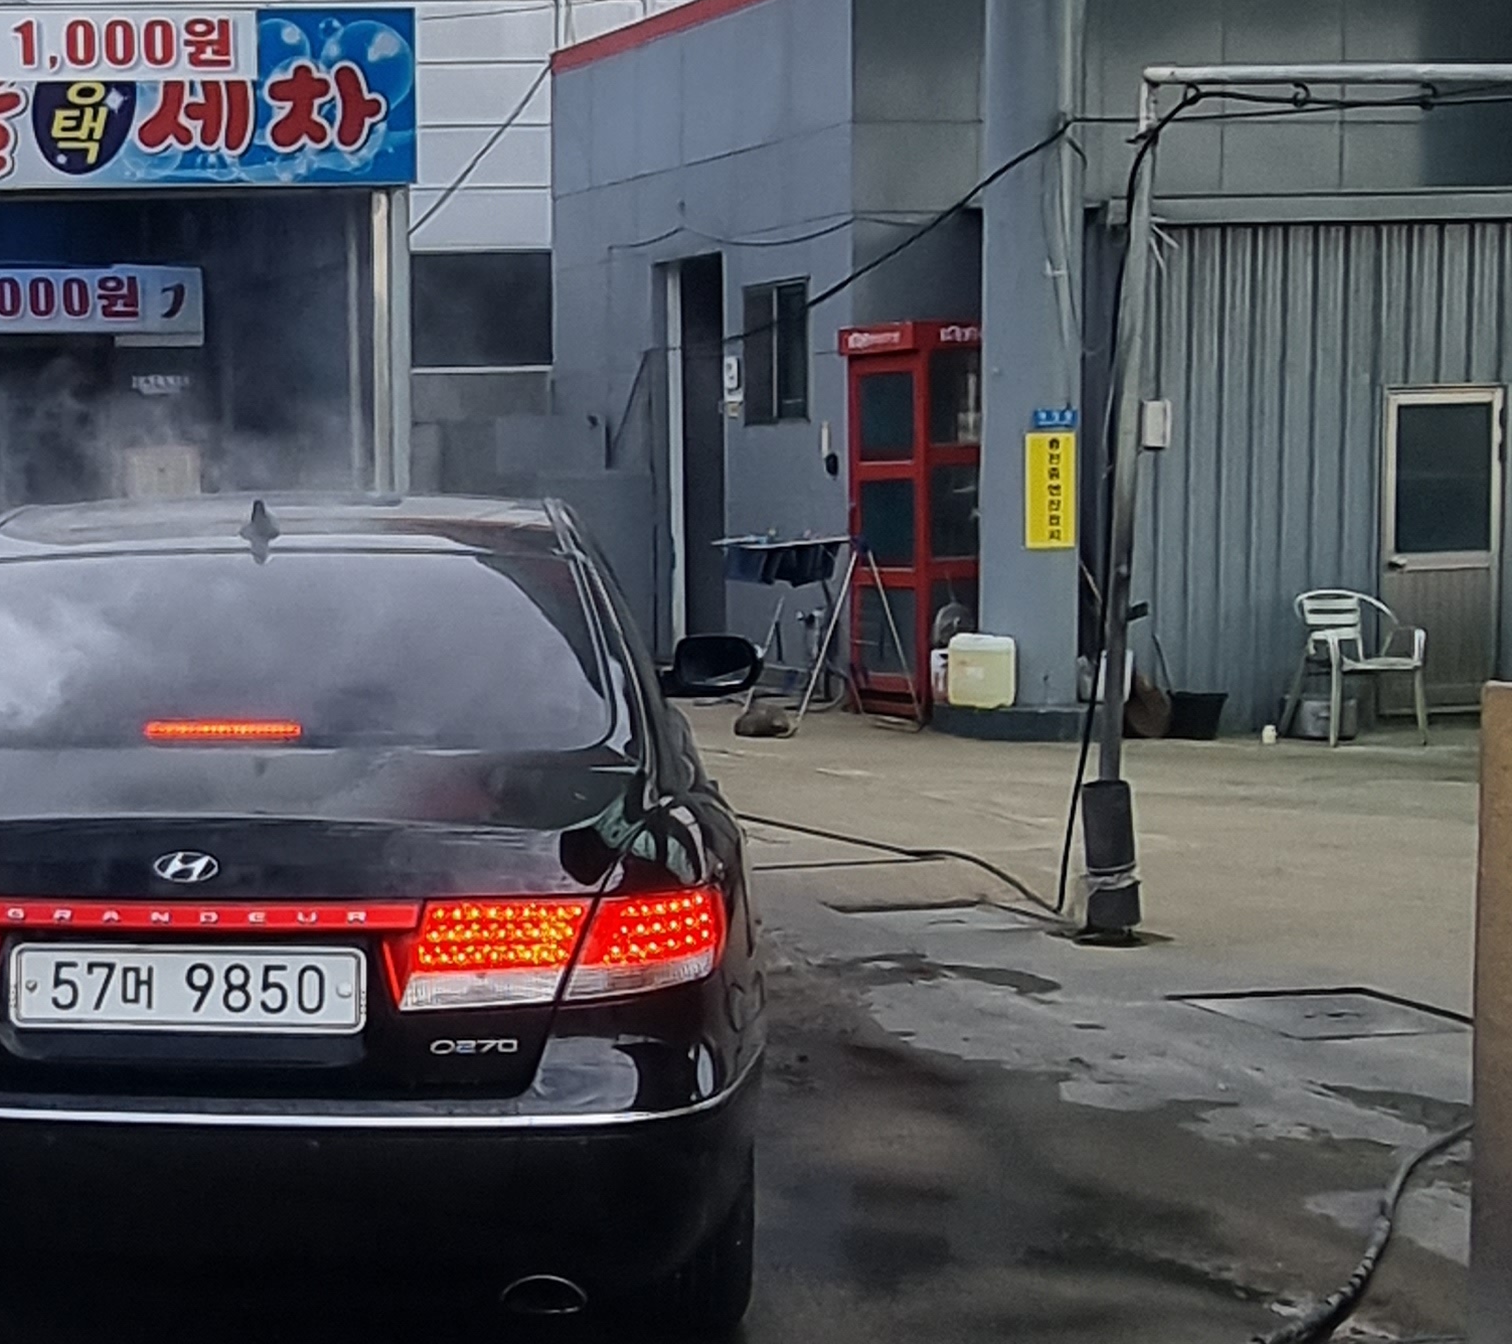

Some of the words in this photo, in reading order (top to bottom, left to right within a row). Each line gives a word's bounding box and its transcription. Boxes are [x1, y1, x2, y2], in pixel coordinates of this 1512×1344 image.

[13, 18, 233, 70] 1,000원
[137, 64, 383, 152] 세차
[6, 907, 369, 925] GRANDEUR
[51, 961, 156, 1012] 57머
[185, 962, 327, 1016] 9850
